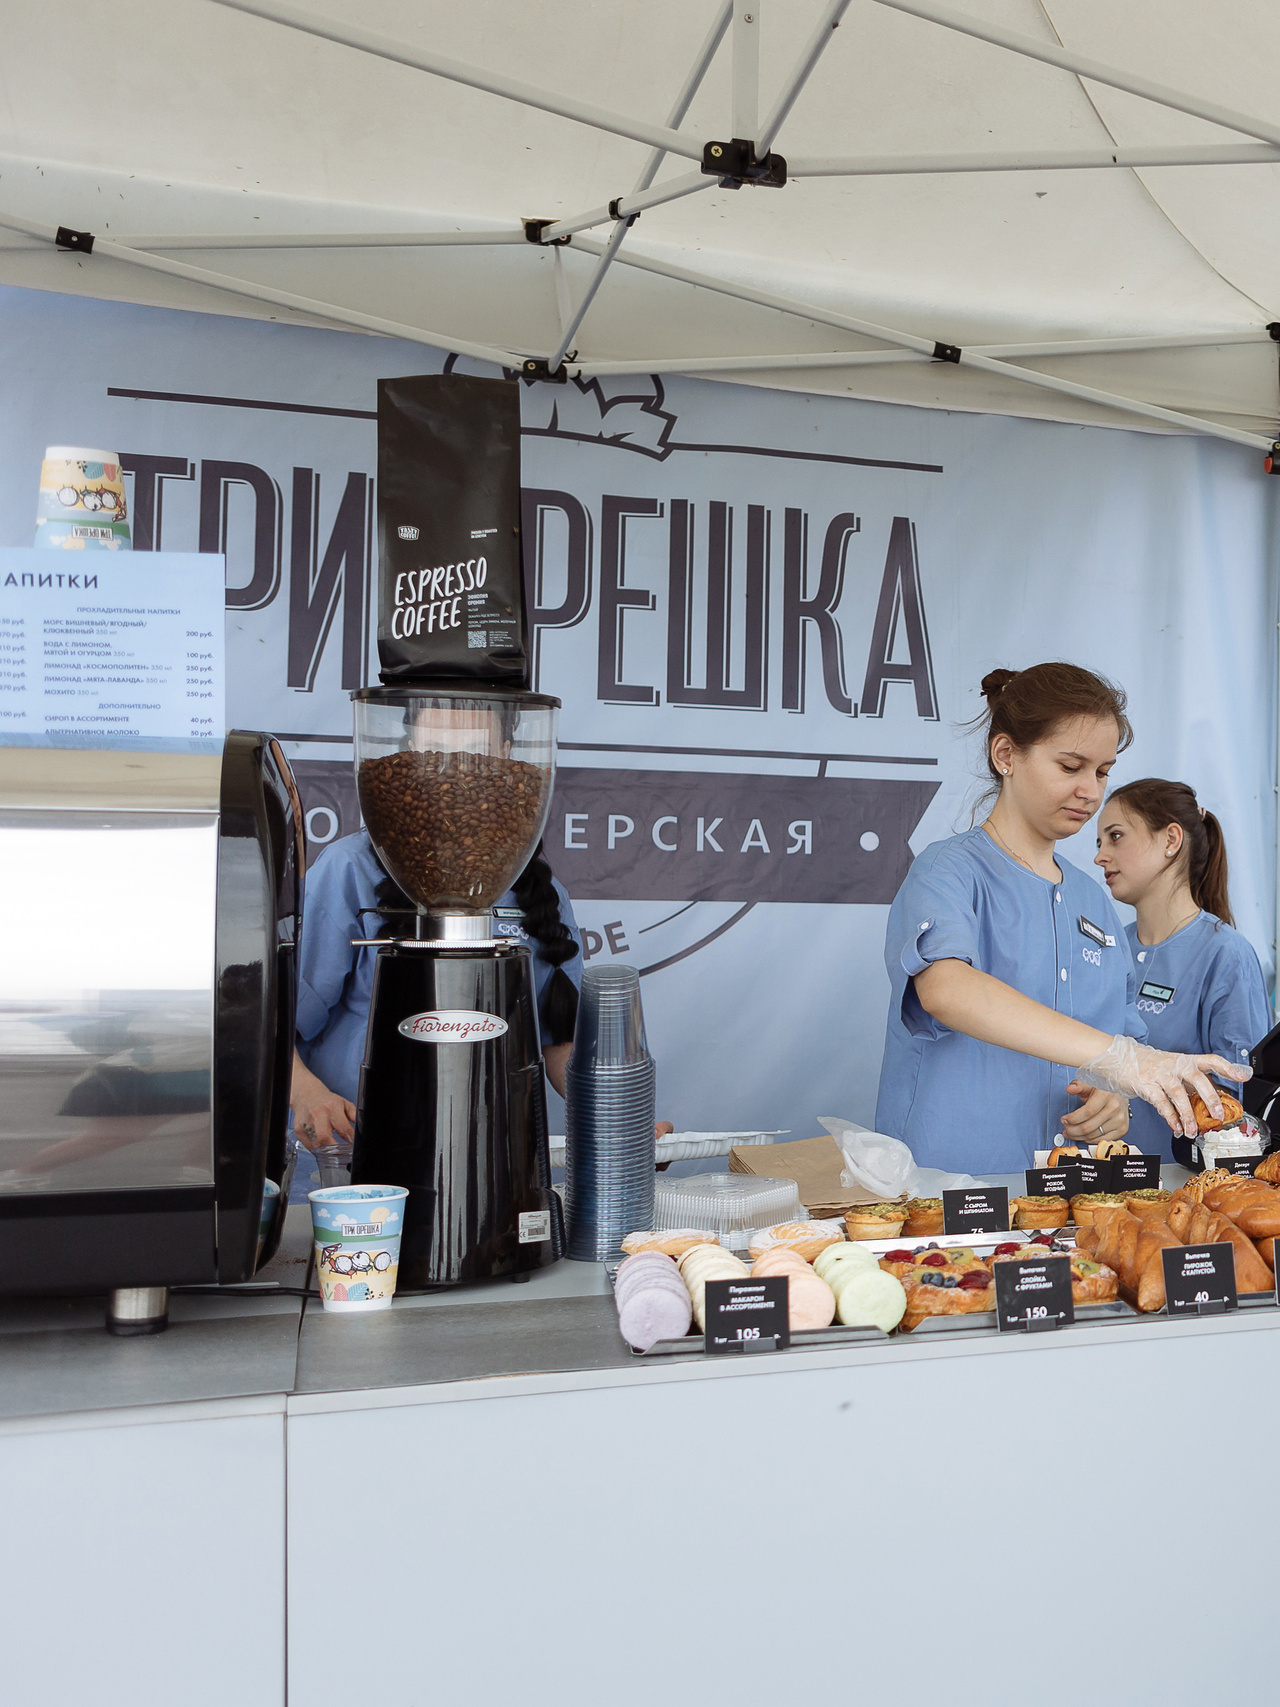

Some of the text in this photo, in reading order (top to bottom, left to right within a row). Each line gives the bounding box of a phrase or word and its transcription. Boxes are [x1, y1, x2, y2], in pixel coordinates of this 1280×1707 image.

[0, 572, 98, 589] АПИТКИ
[394, 556, 488, 606] ESPRESSO
[514, 487, 941, 722] РЕШКА
[391, 597, 463, 640] COFFEE
[412, 1016, 497, 1039] Fiorenzato
[344, 1224, 380, 1235] ТРИ ОРЕШКА
[1185, 1252, 1211, 1260] Выпечка
[1183, 1261, 1213, 1269] ПИРОЖОК
[1019, 1266, 1046, 1275] Выпечка
[1186, 1266, 1216, 1276] КАПУСТОЙ
[1020, 1275, 1046, 1284] СЛОЙКА
[729, 1285, 766, 1294] Пирожные
[1020, 1281, 1053, 1291] ФРУКТАМИ
[730, 1295, 765, 1303] МАКАРОН
[1195, 1291, 1209, 1302] 40
[725, 1301, 775, 1311] АССОРТИМЕНТЕ
[1025, 1305, 1048, 1319] 150
[736, 1327, 760, 1340] 105
